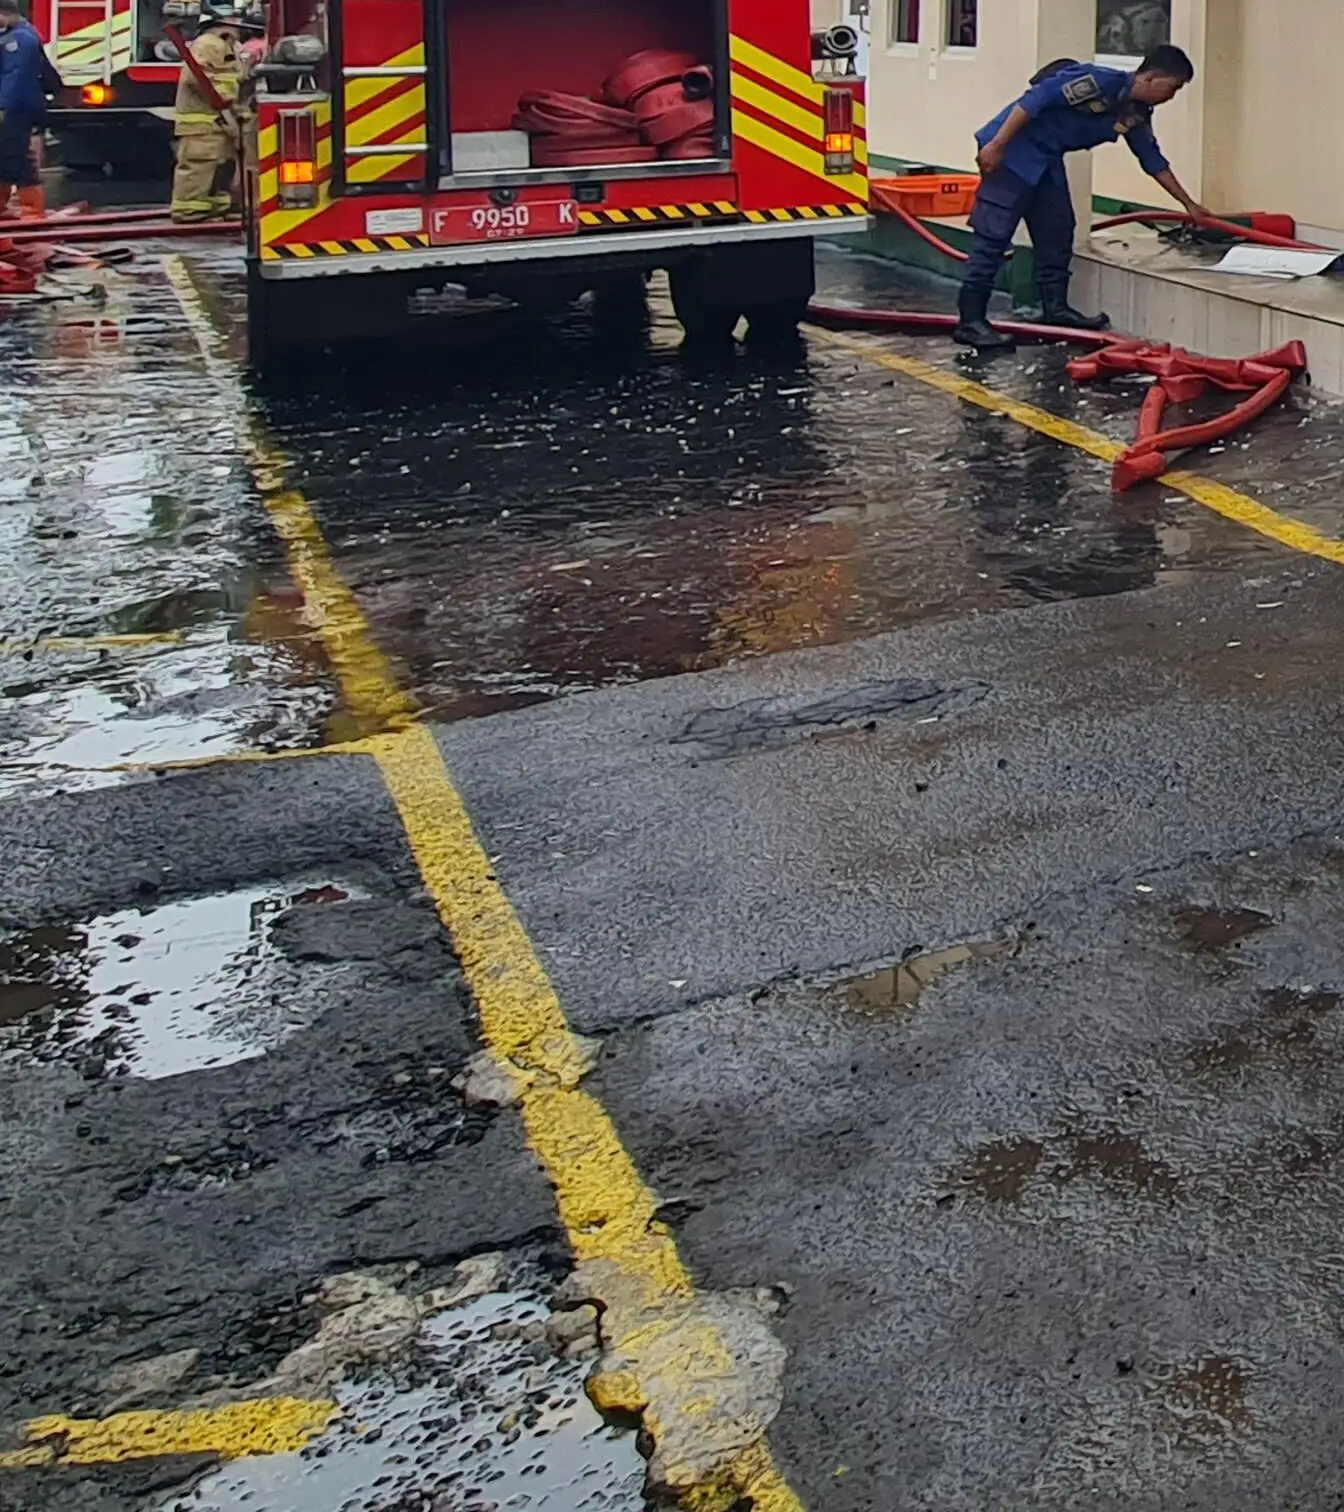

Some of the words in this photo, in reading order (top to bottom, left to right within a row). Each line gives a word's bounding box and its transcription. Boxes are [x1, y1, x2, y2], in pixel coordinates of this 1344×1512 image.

[434, 211, 449, 233] F
[472, 205, 530, 230] 9950
[559, 203, 574, 224] K
